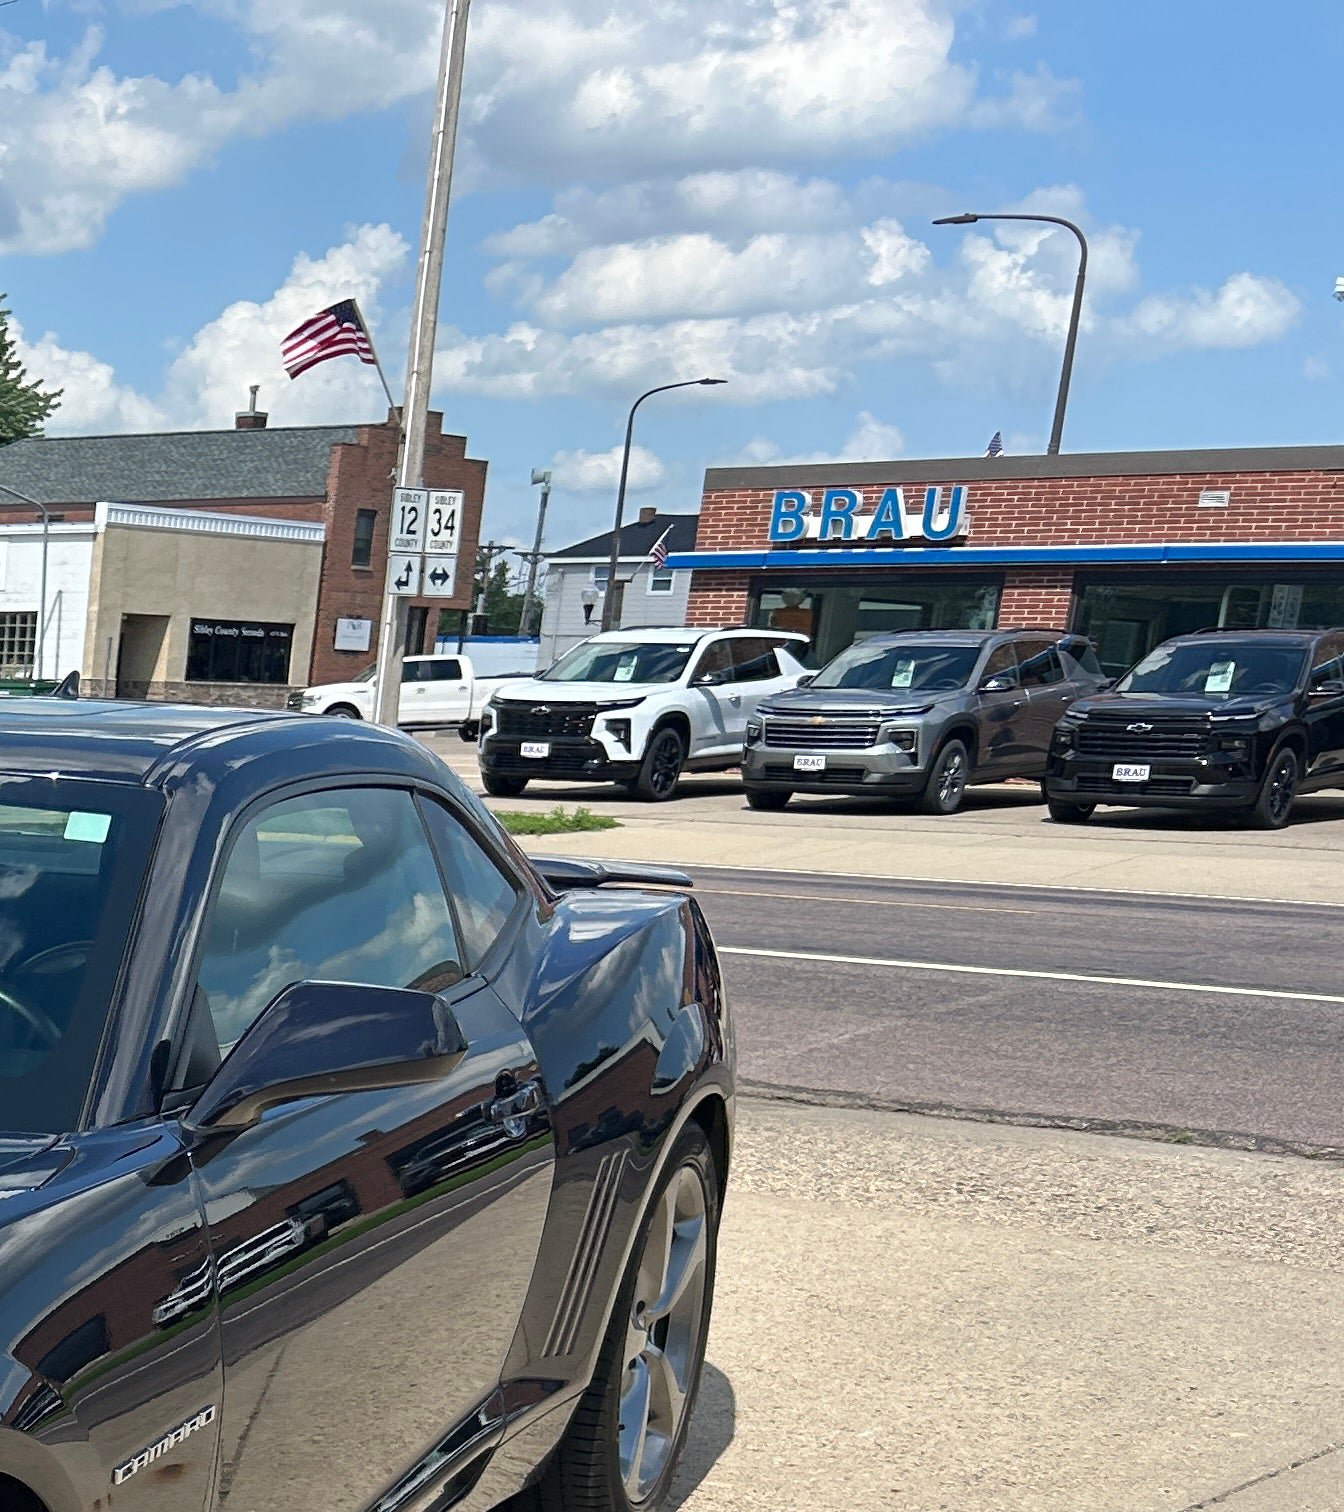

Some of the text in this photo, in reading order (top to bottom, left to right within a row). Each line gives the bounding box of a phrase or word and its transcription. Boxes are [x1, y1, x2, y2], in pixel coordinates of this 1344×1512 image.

[400, 493, 422, 503] SIBLEY
[434, 496, 456, 505] SIBLEY
[768, 485, 969, 541] BRAU
[399, 505, 418, 535] 12
[431, 508, 456, 537] 34
[395, 538, 418, 547] COUNTY
[429, 540, 454, 549] COUNTY
[1115, 767, 1148, 777] BRAU
[113, 1404, 216, 1485] CAMARO
